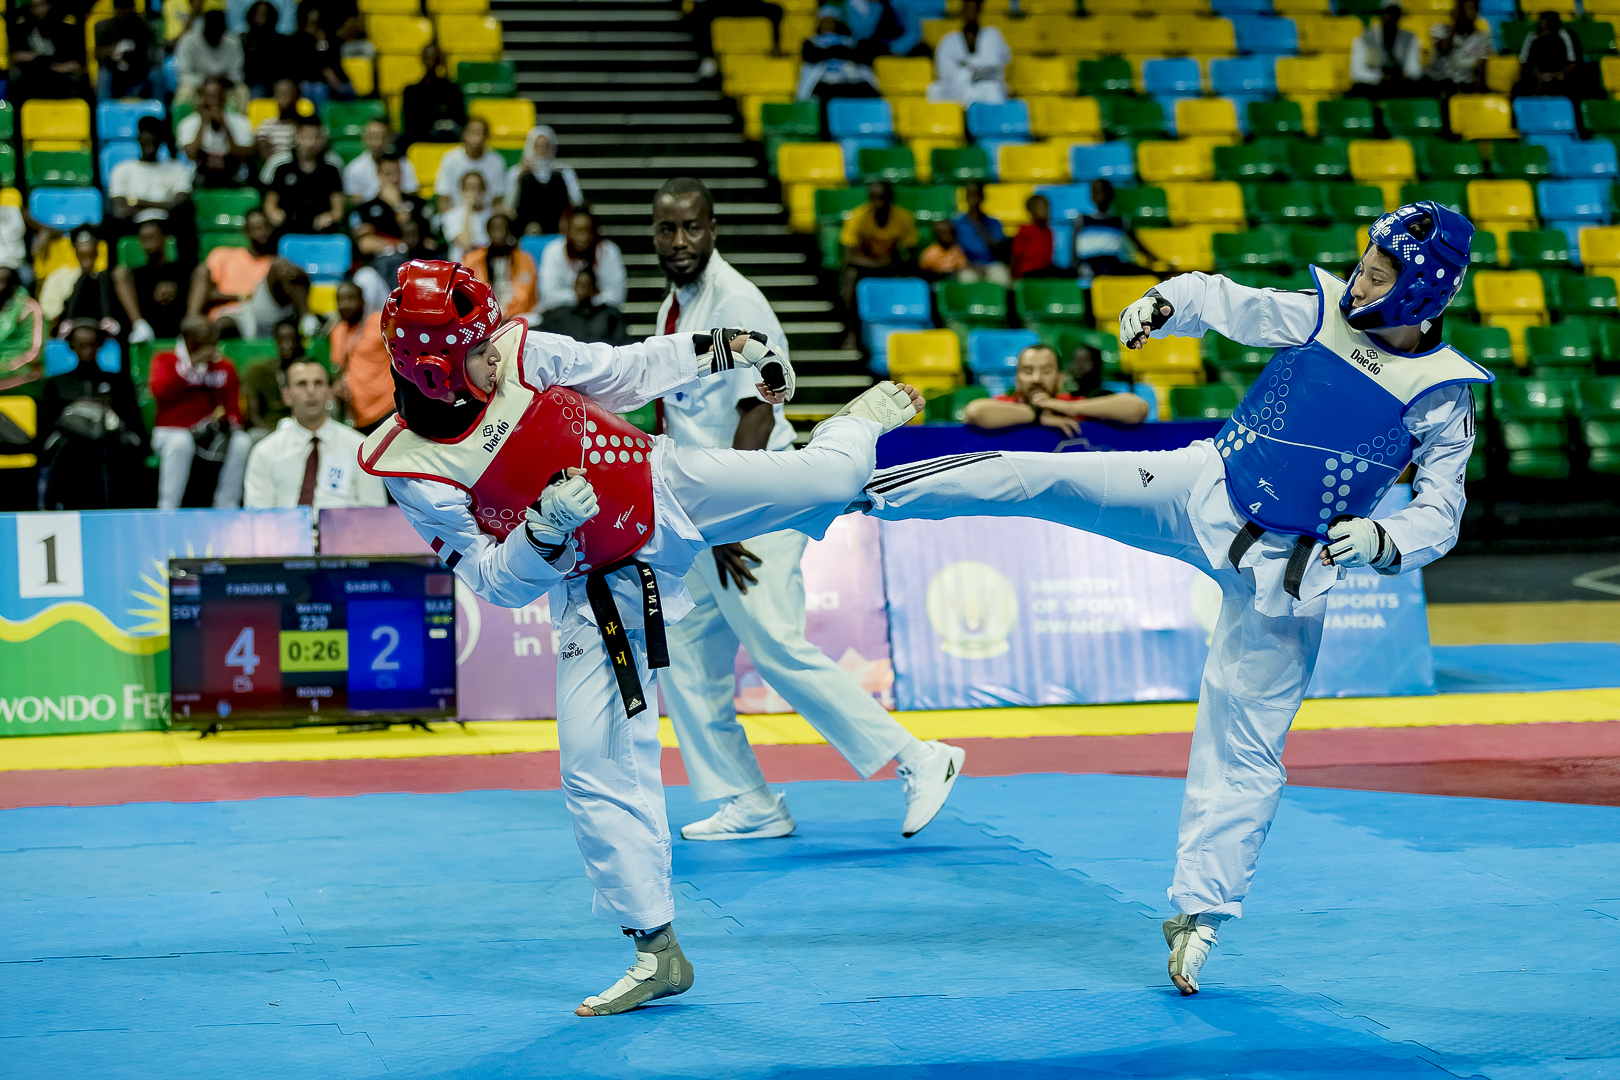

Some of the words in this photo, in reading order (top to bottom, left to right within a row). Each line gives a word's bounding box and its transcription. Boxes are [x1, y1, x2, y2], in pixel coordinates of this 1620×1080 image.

[1249, 502, 1262, 515] 4
[635, 522, 648, 535] 4
[36, 534, 60, 585] 1
[225, 627, 260, 675] 4
[288, 641, 340, 661] 0:26
[370, 626, 400, 670] 2
